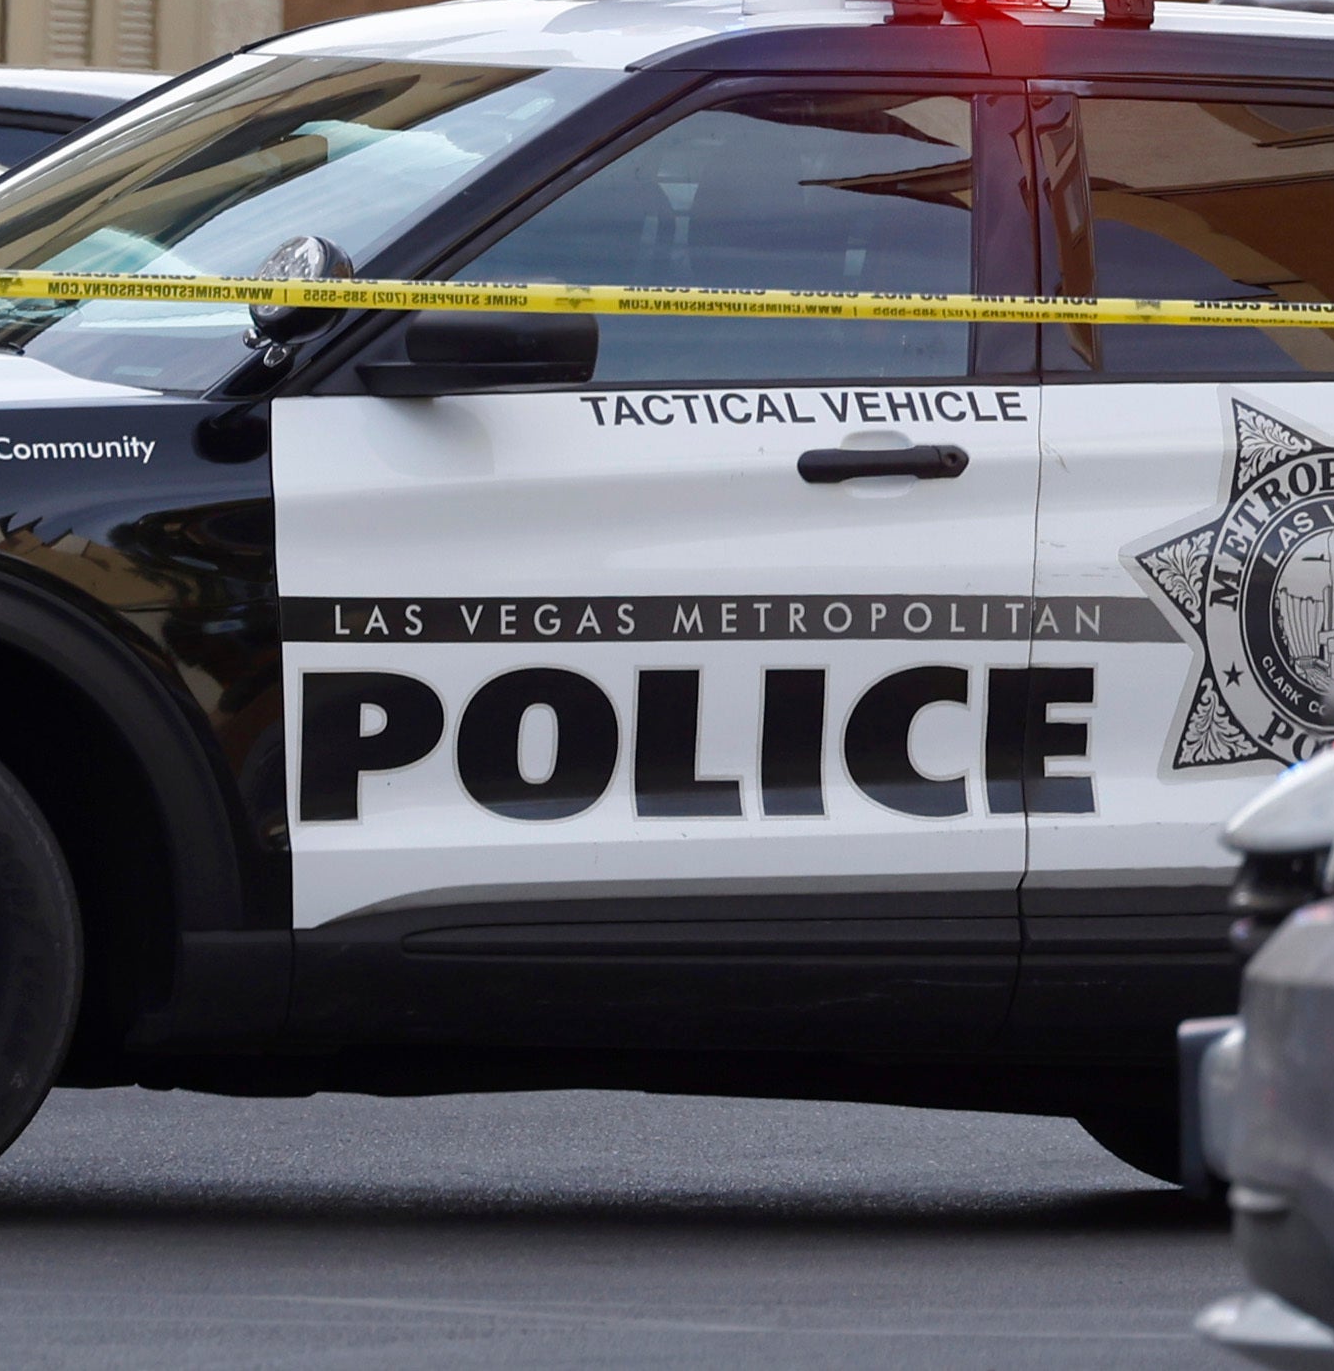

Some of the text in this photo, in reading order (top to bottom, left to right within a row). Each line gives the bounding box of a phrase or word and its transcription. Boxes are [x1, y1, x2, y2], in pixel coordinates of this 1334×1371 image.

[580, 390, 1028, 426] TACTICAL VEHICLE
[1262, 510, 1315, 568] LAS
[334, 602, 1101, 637] LAS VEGAS METROPOLITAN
[1261, 655, 1301, 706] CLARK
[298, 664, 1098, 824] POLICE
